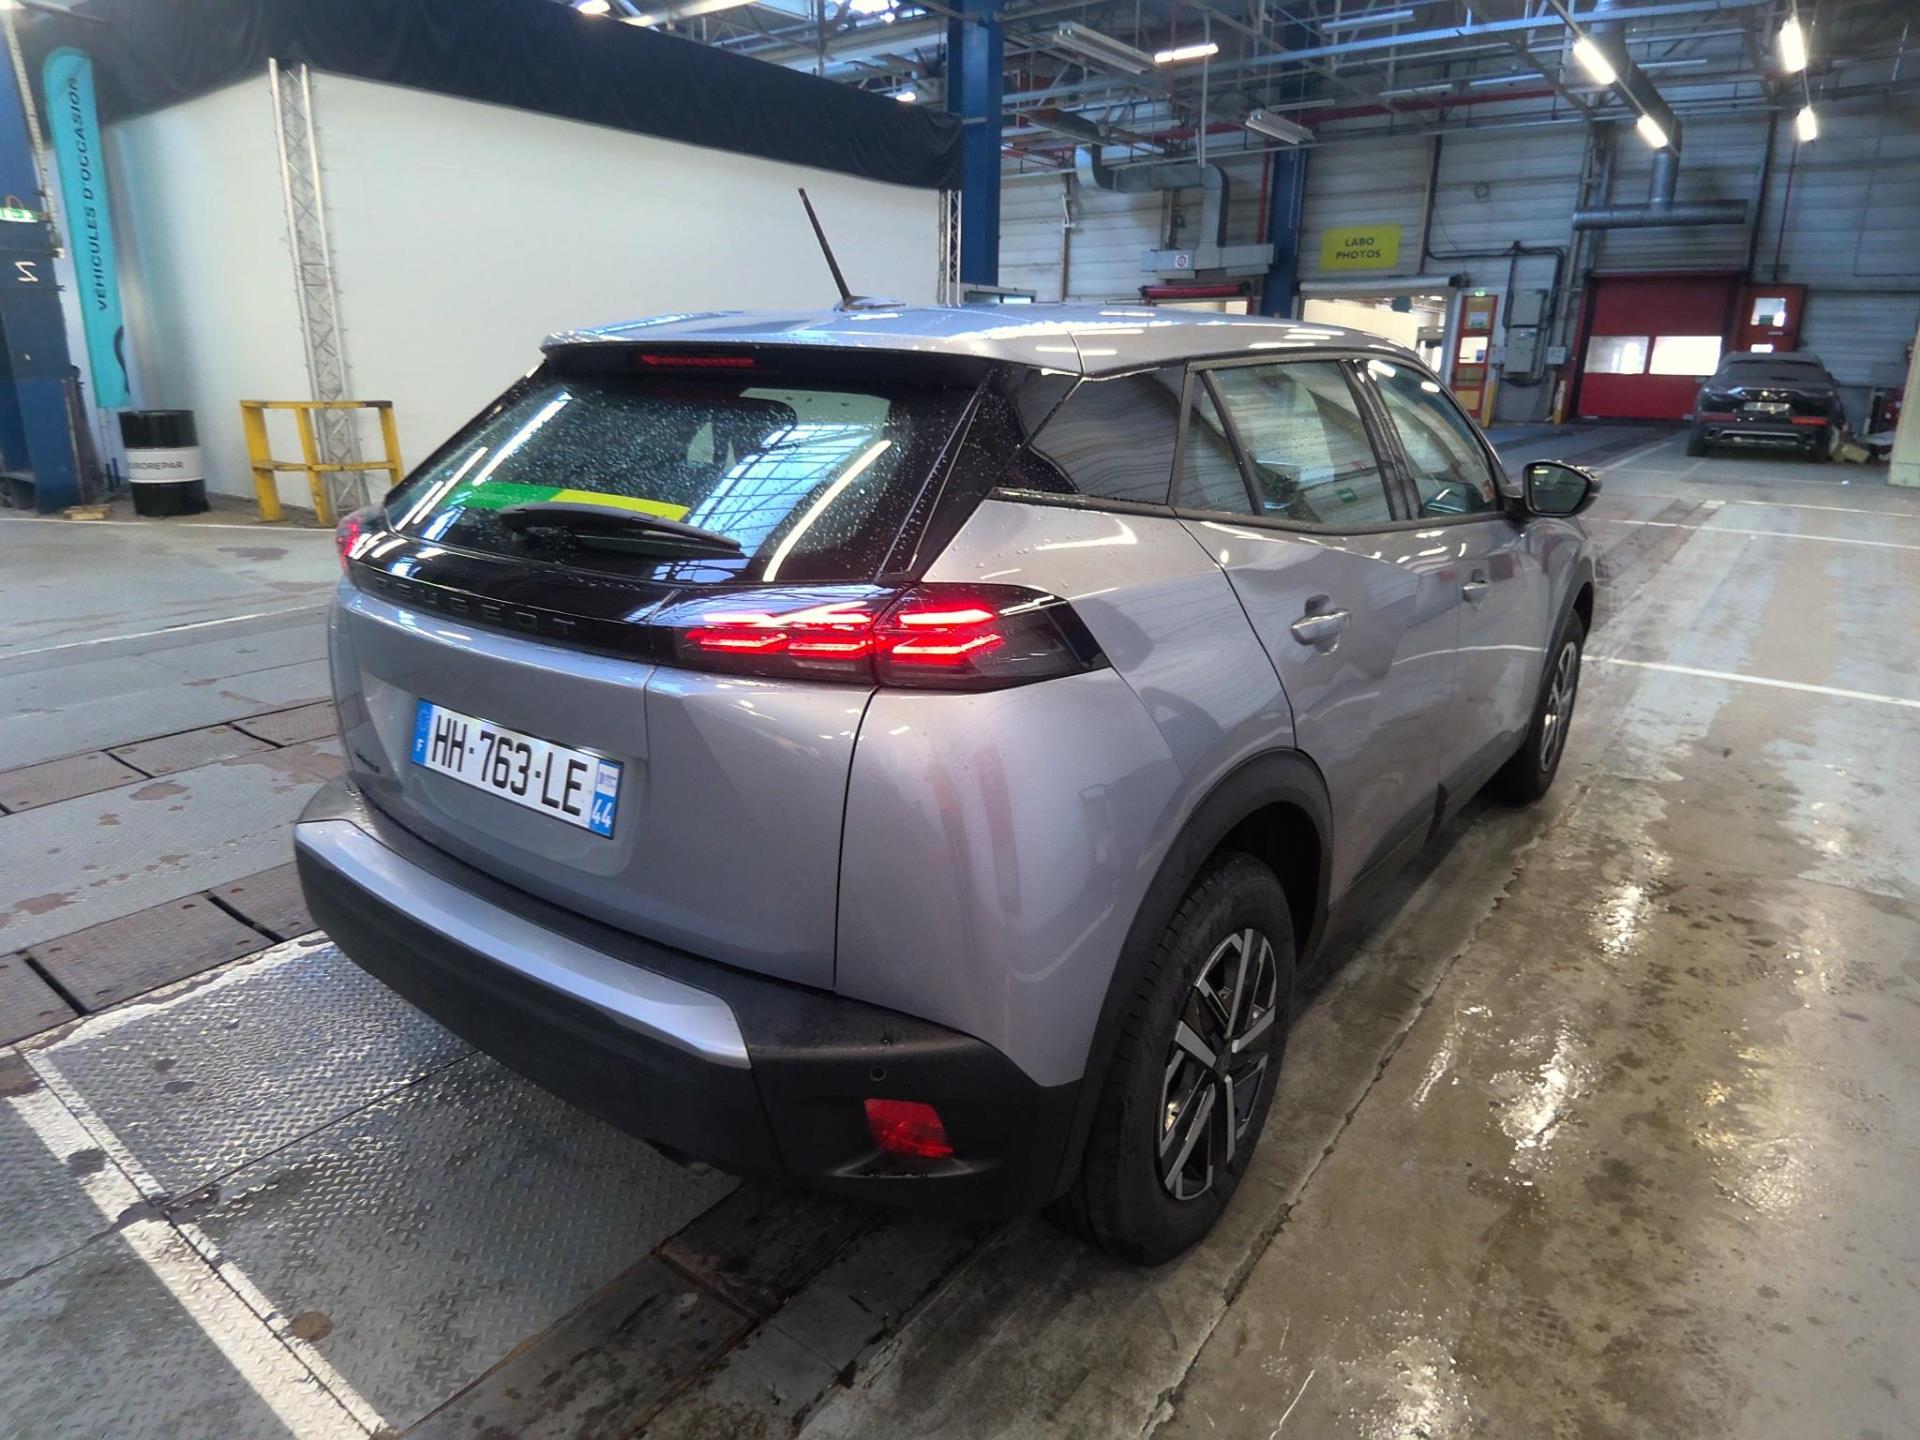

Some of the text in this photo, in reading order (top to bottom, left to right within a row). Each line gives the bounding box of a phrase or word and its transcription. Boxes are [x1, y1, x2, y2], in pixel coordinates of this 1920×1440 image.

[1345, 237, 1375, 247] LABO
[1336, 249, 1381, 260] PHOTOS
[375, 576, 576, 635] PEUGEOT
[592, 798, 612, 828] 44
